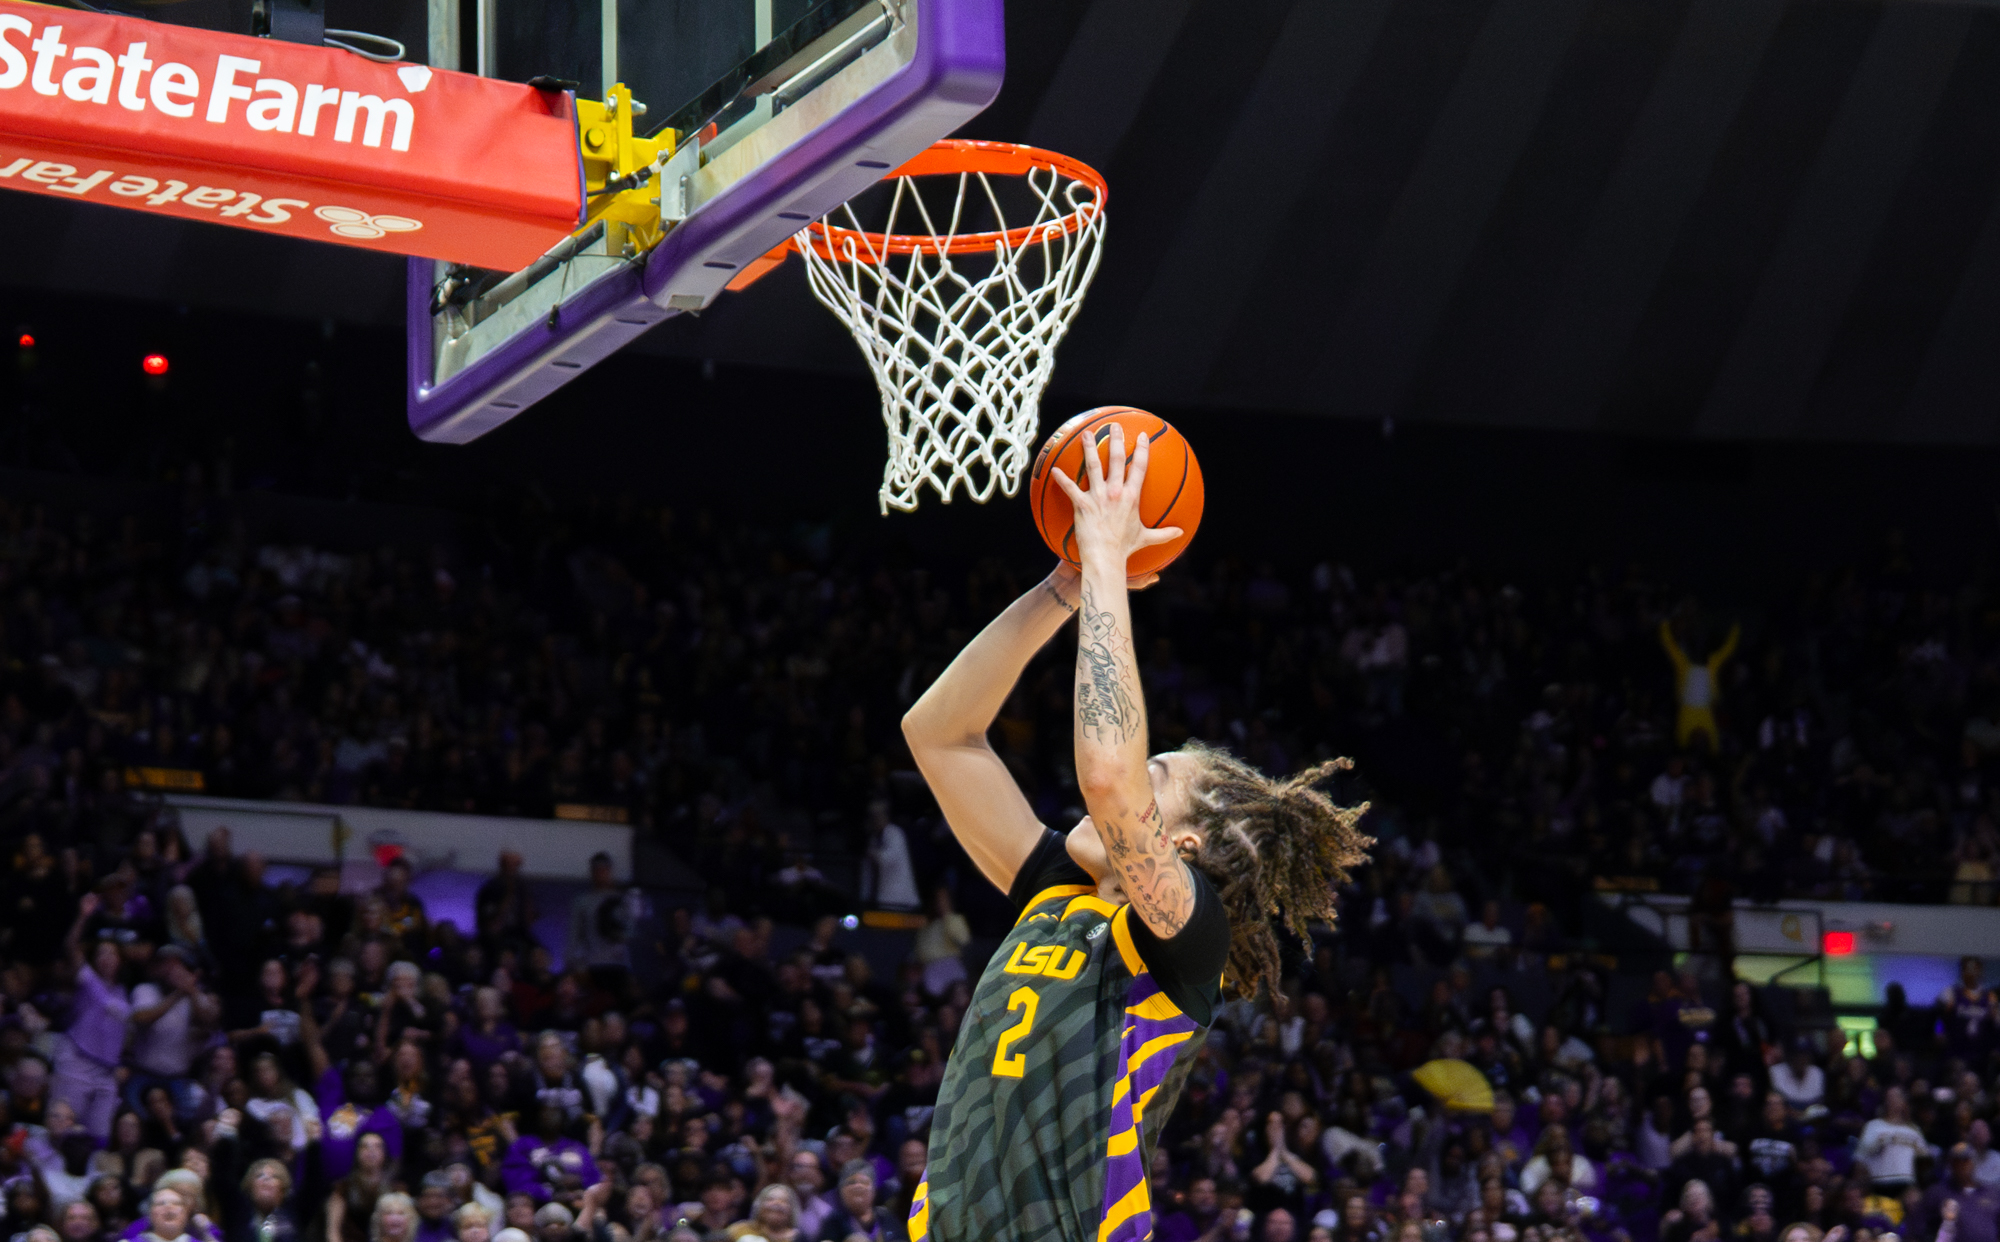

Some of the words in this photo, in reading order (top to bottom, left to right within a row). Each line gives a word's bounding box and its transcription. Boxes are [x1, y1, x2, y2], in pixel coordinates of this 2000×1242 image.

[0, 13, 200, 118] State
[206, 54, 415, 152] Farm
[0, 155, 115, 196] Far
[108, 173, 310, 224] State
[1003, 941, 1088, 980] LSU
[991, 985, 1040, 1079] 2
